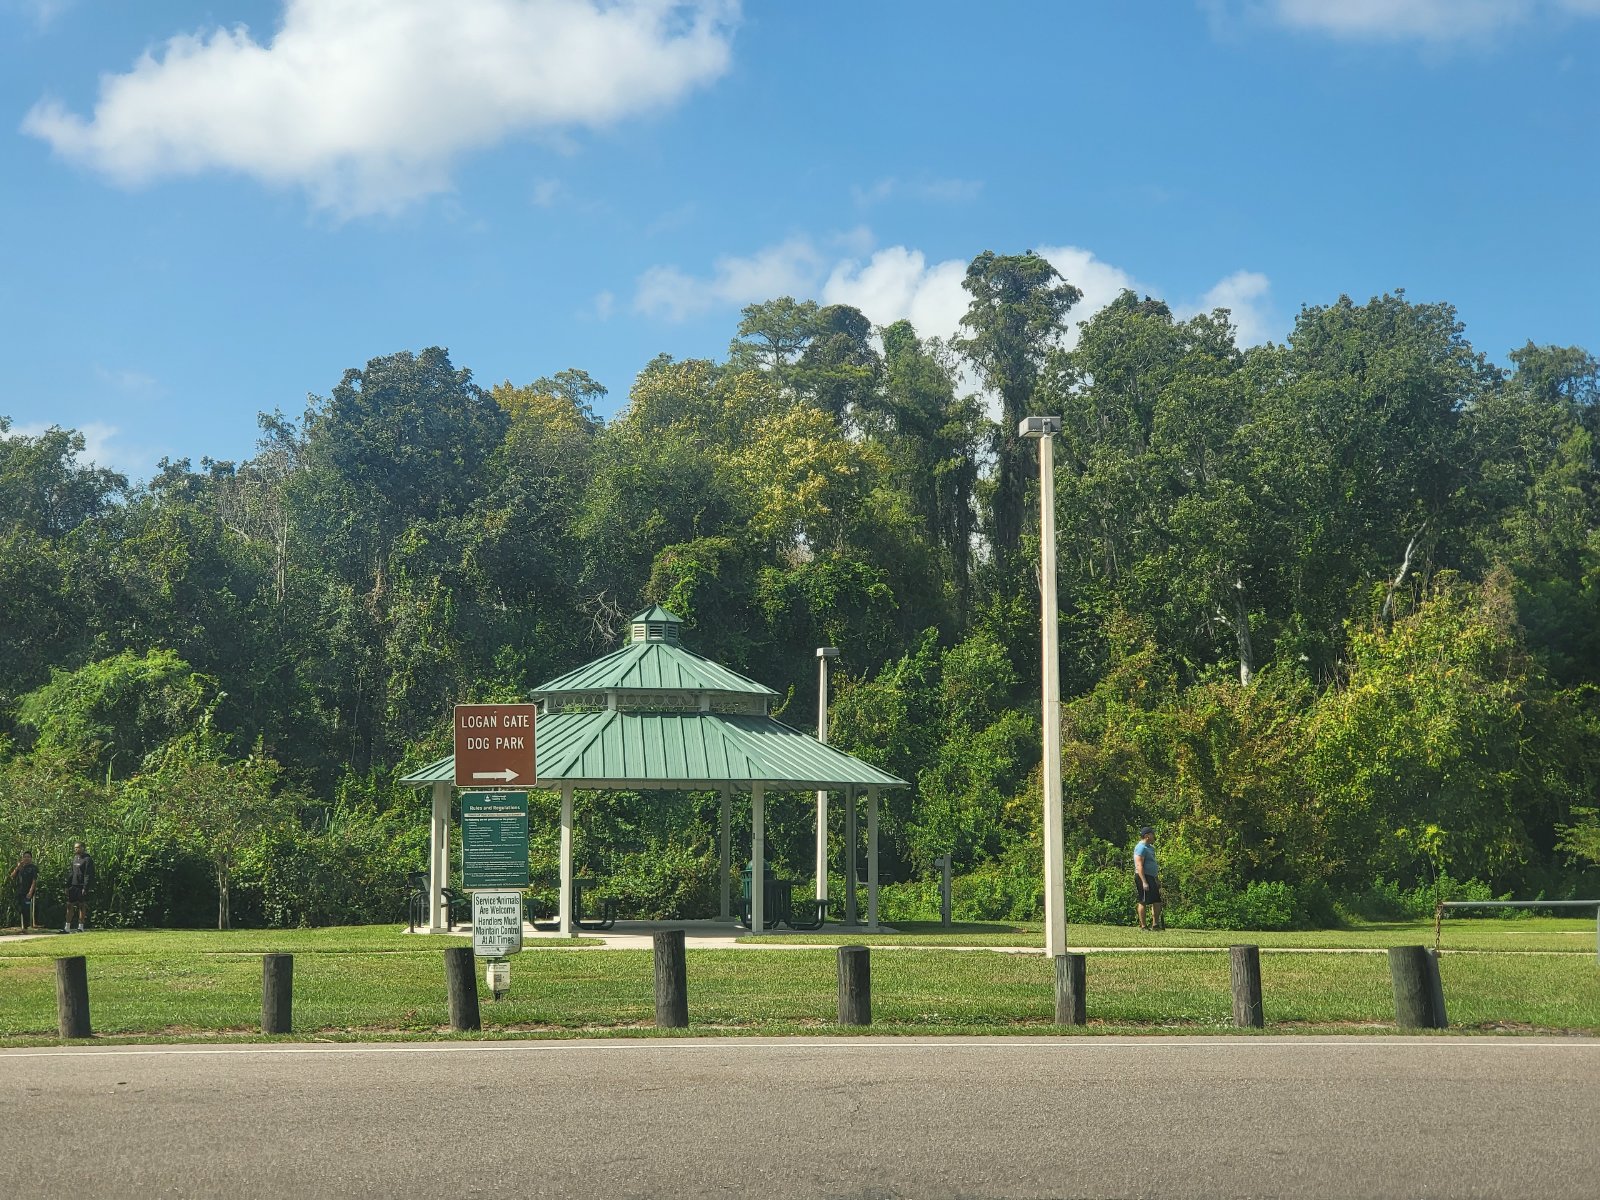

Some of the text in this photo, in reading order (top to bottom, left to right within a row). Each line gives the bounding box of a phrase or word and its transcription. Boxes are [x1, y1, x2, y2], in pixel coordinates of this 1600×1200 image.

[461, 715, 530, 728] LOGAN GATE
[467, 736, 524, 750] DOG PARK
[476, 896, 519, 905] Service Animals
[480, 906, 515, 914] Are Welcome
[478, 917, 517, 925] Handlers Must
[476, 926, 519, 935] Maintain Control
[482, 936, 487, 944] At
[497, 936, 514, 944] Times
